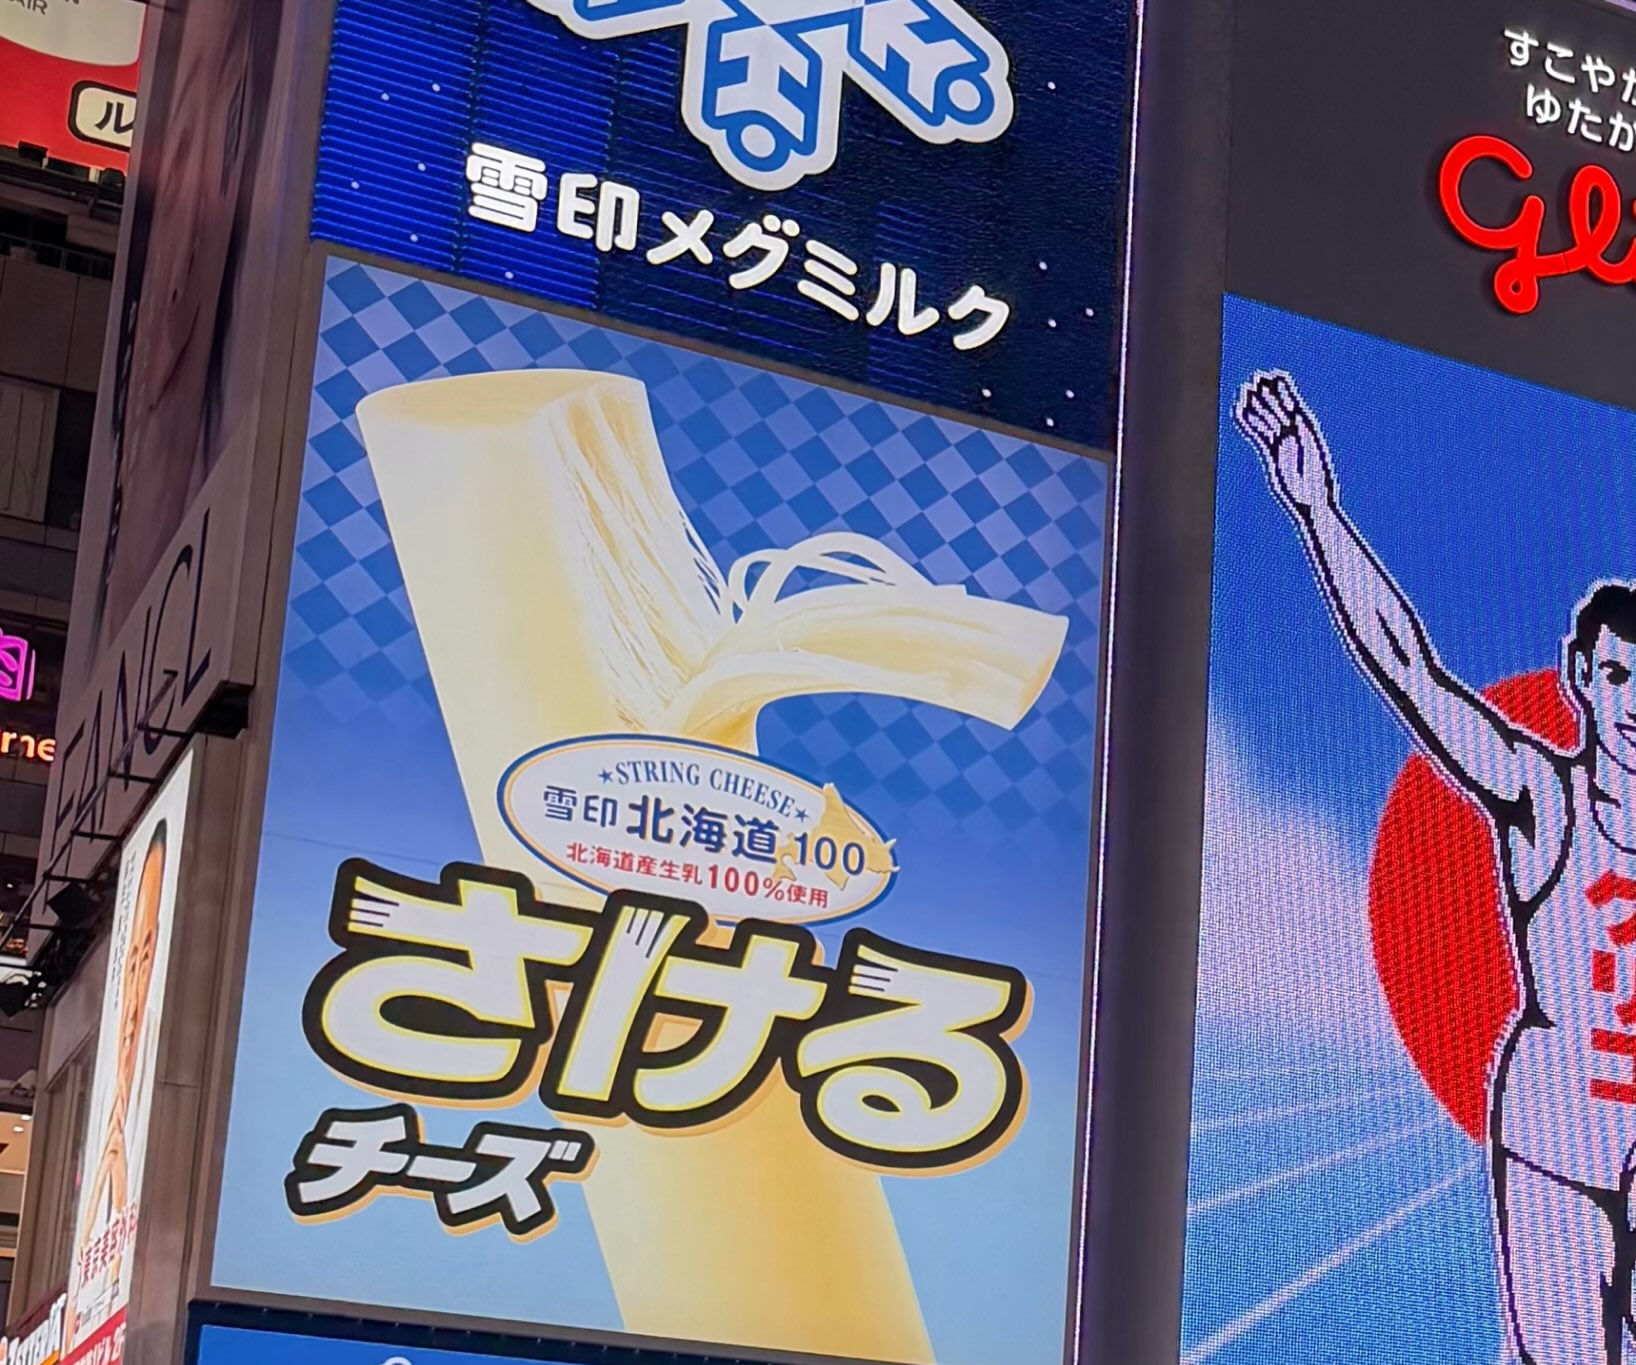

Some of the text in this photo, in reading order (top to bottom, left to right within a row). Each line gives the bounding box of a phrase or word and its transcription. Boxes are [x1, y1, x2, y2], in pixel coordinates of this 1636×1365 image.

[465, 142, 1010, 351] 雪印メグミルク
[615, 760, 796, 819] STRING CHEESE
[566, 841, 829, 908] 北海道産生乳100%使用
[308, 862, 1020, 1160] さける
[287, 1107, 589, 1232] チーズ
